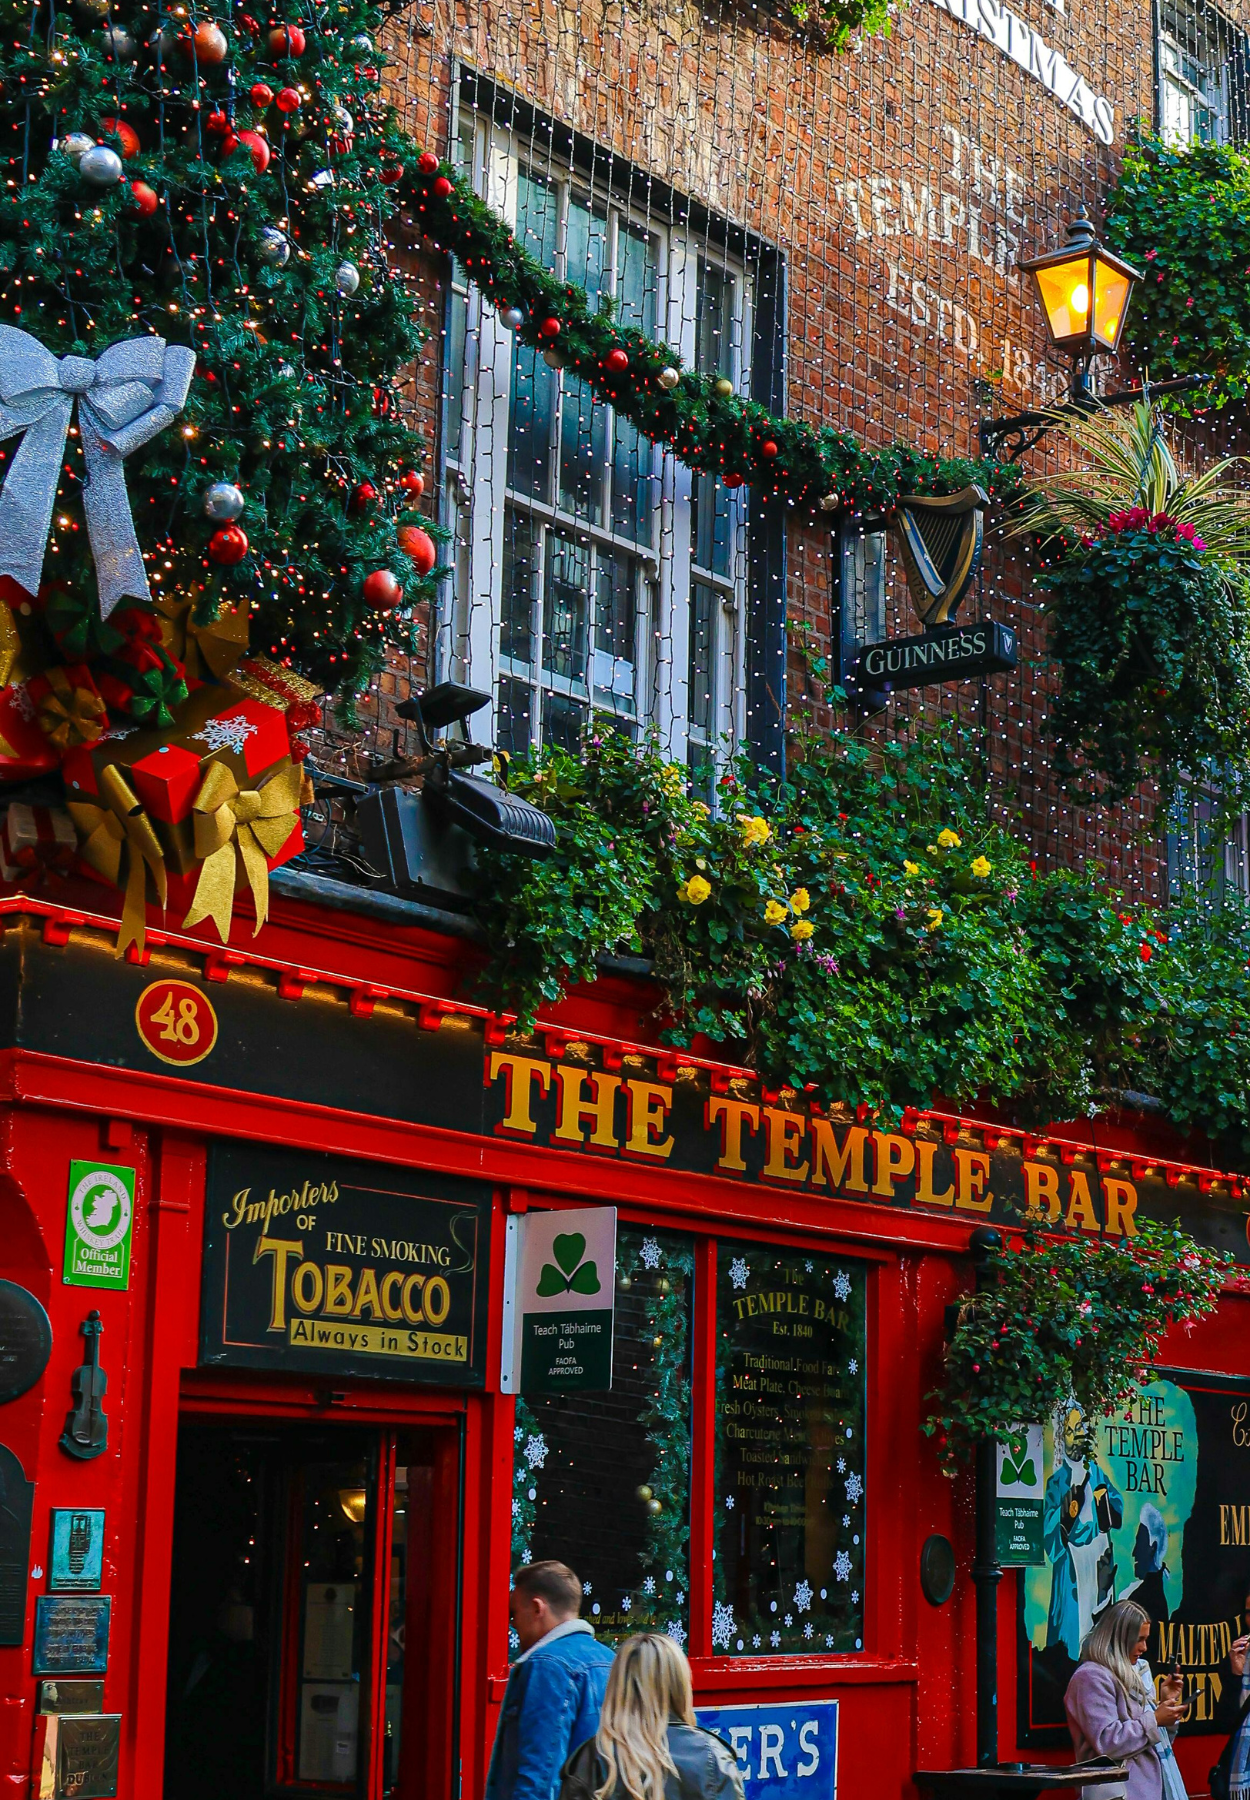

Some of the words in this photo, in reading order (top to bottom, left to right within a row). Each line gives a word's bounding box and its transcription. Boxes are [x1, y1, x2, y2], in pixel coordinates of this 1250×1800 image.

[930, 0, 1115, 146] ISTMAS
[943, 127, 1028, 227] THE
[835, 177, 1019, 284] TEMPLE
[865, 632, 987, 675] GUINNESS
[150, 991, 199, 1045] 48
[490, 1052, 675, 1158] THE
[709, 1095, 995, 1214] TEMPLE
[1023, 1161, 1139, 1237] BAR
[222, 1180, 340, 1235] Importers
[296, 1215, 317, 1231] OF
[80, 1248, 118, 1263] Official
[325, 1231, 367, 1255] FINE
[371, 1237, 451, 1267] SMOKING
[75, 1260, 121, 1276] Member
[252, 1234, 451, 1333] TOBACCO
[533, 1324, 557, 1335] Teach
[560, 1322, 602, 1335] Tábhairne
[733, 1292, 809, 1320] TEMPLE
[813, 1299, 850, 1333] BAR
[773, 1321, 790, 1335] Est.
[793, 1324, 813, 1338] 1840
[293, 1321, 369, 1350] Always
[381, 1331, 398, 1350] in
[408, 1332, 464, 1357] Stock
[559, 1338, 575, 1349] Pub
[548, 1366, 583, 1375] APPROVED
[743, 1353, 794, 1371] Traditional
[796, 1358, 819, 1373] Food
[732, 1374, 757, 1391] Meat
[1104, 1425, 1185, 1462] TEMPLE
[737, 1471, 755, 1486] Hot
[1126, 1461, 1168, 1496] BAR
[1014, 1519, 1024, 1529] Pub
[1157, 1618, 1232, 1667] MALTED
[714, 1718, 820, 1782] ER'S
